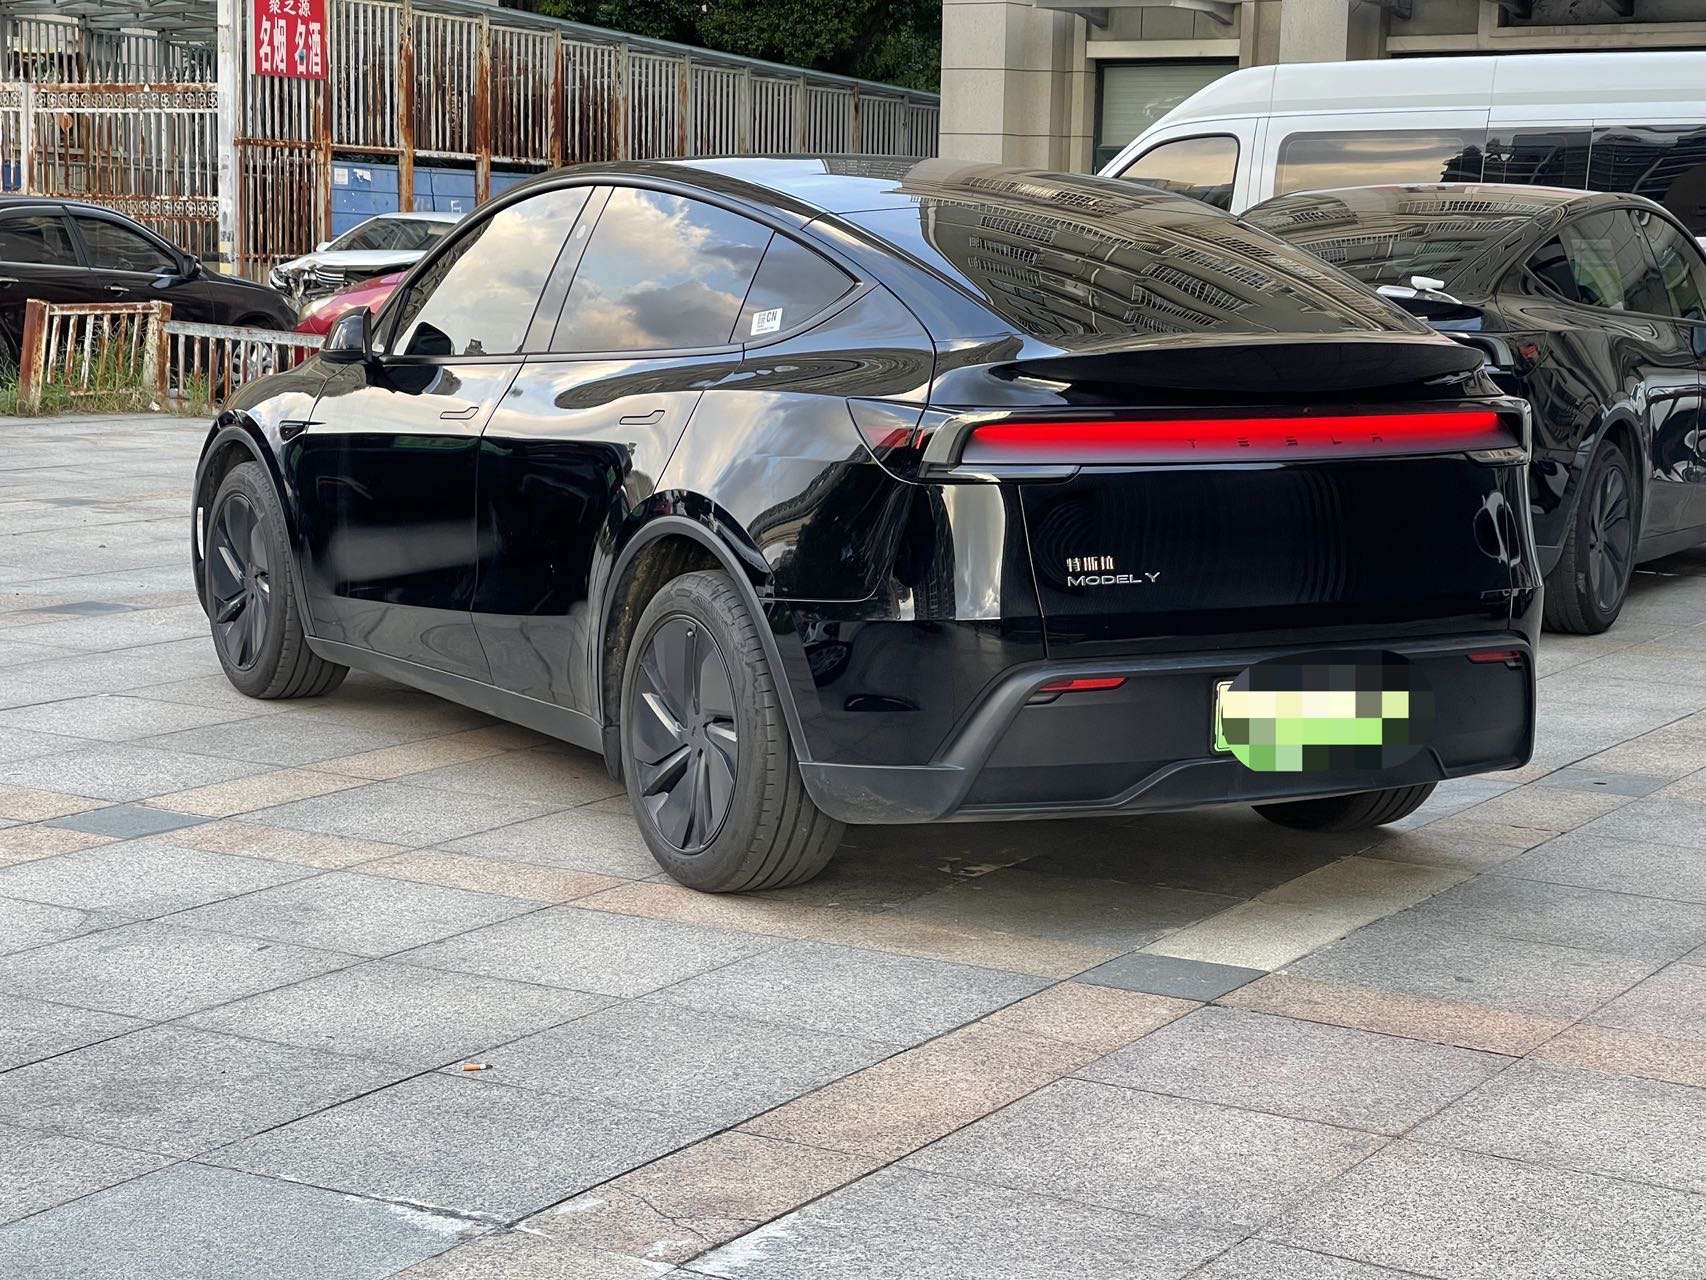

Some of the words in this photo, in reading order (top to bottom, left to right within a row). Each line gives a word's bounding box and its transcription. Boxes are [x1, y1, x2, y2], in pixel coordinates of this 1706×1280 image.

[259, 14, 287, 74] 名烟
[294, 17, 321, 76] 名酒
[766, 310, 778, 323] CN
[1186, 432, 1384, 449] TESLA
[1066, 555, 1115, 573] 特斯拉
[1067, 574, 1143, 587] MODEL
[1144, 571, 1161, 583] Y
